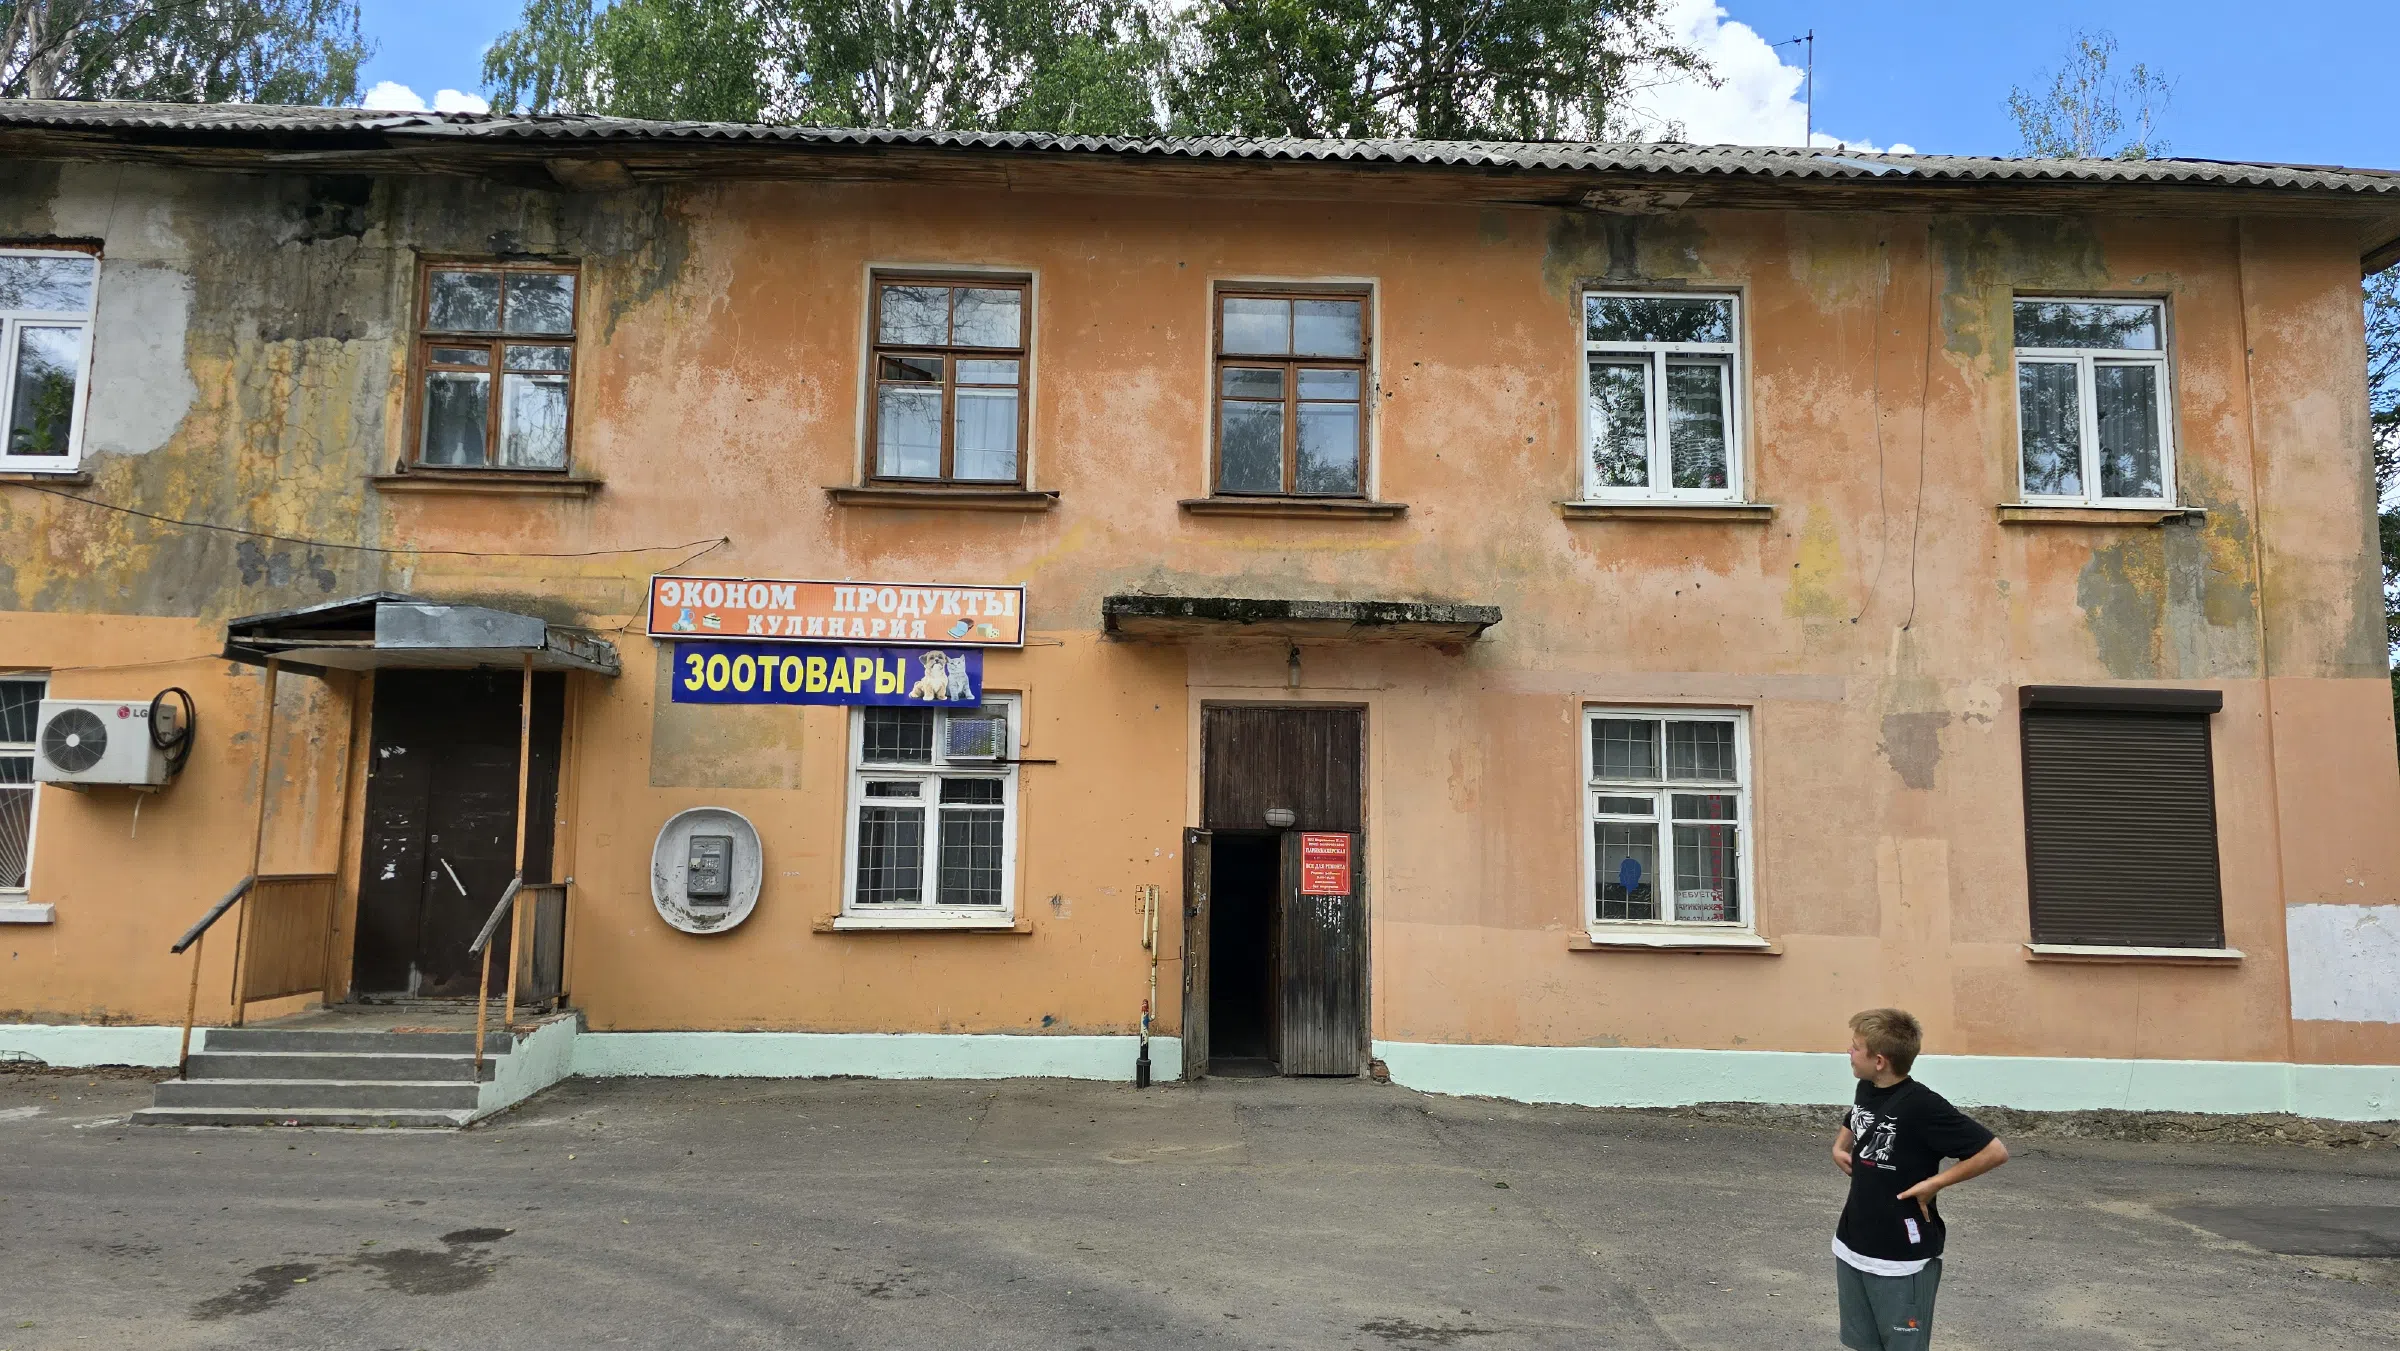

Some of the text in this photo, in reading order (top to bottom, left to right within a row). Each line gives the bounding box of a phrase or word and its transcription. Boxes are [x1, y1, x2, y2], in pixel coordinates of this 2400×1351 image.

[659, 581, 1015, 619] ЭКОНОМ ПРОДУКТЫ
[746, 614, 927, 639] КУЛИНАРИЯ
[683, 653, 906, 695] ЗООТОВАРЫ
[133, 709, 148, 718] LG
